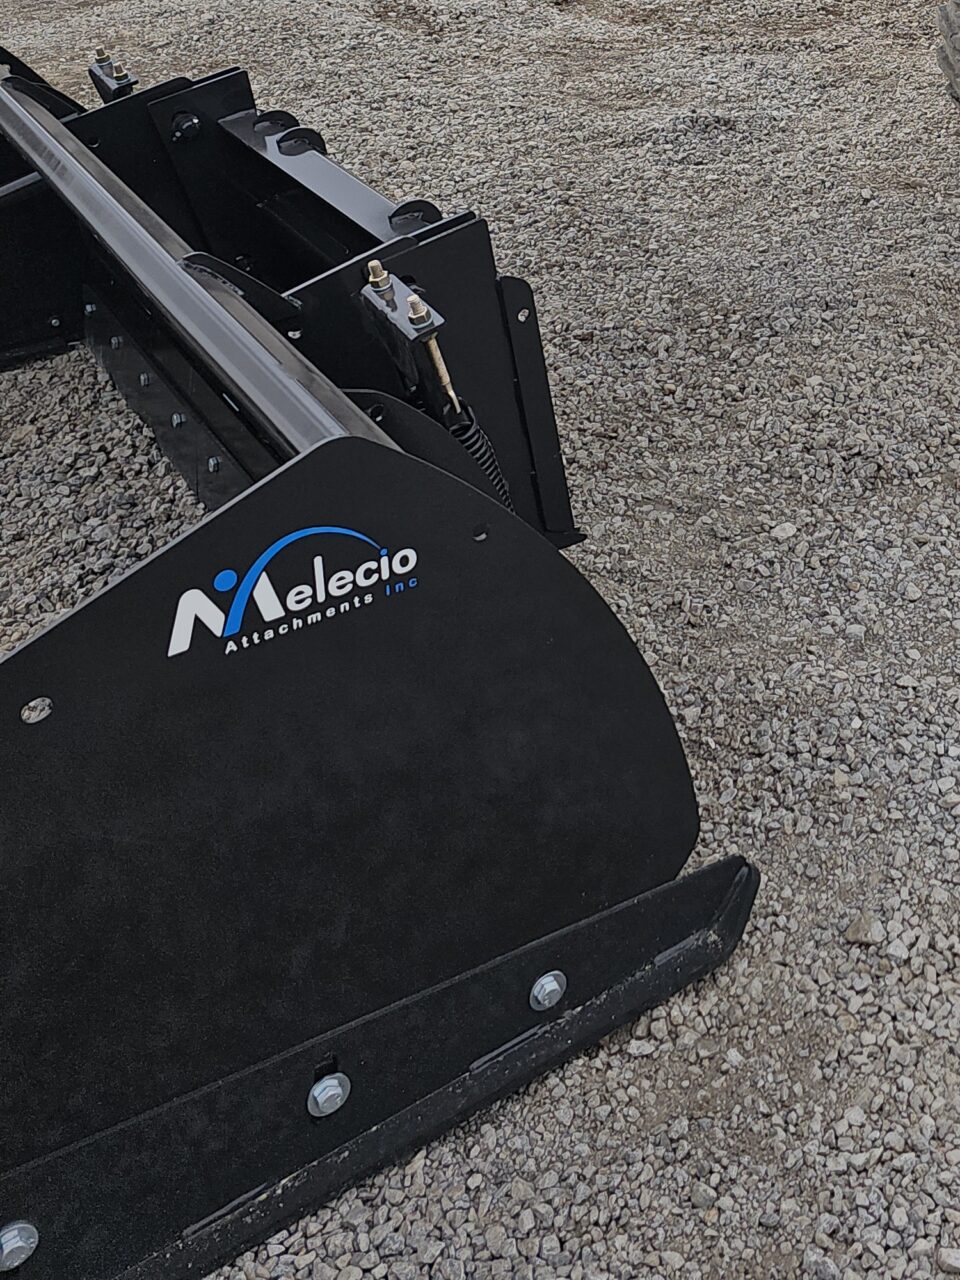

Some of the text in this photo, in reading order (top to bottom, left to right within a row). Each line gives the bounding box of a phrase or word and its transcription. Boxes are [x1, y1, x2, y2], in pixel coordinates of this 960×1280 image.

[167, 526, 418, 657] Melecio
[225, 577, 418, 655] Attachments Inc
